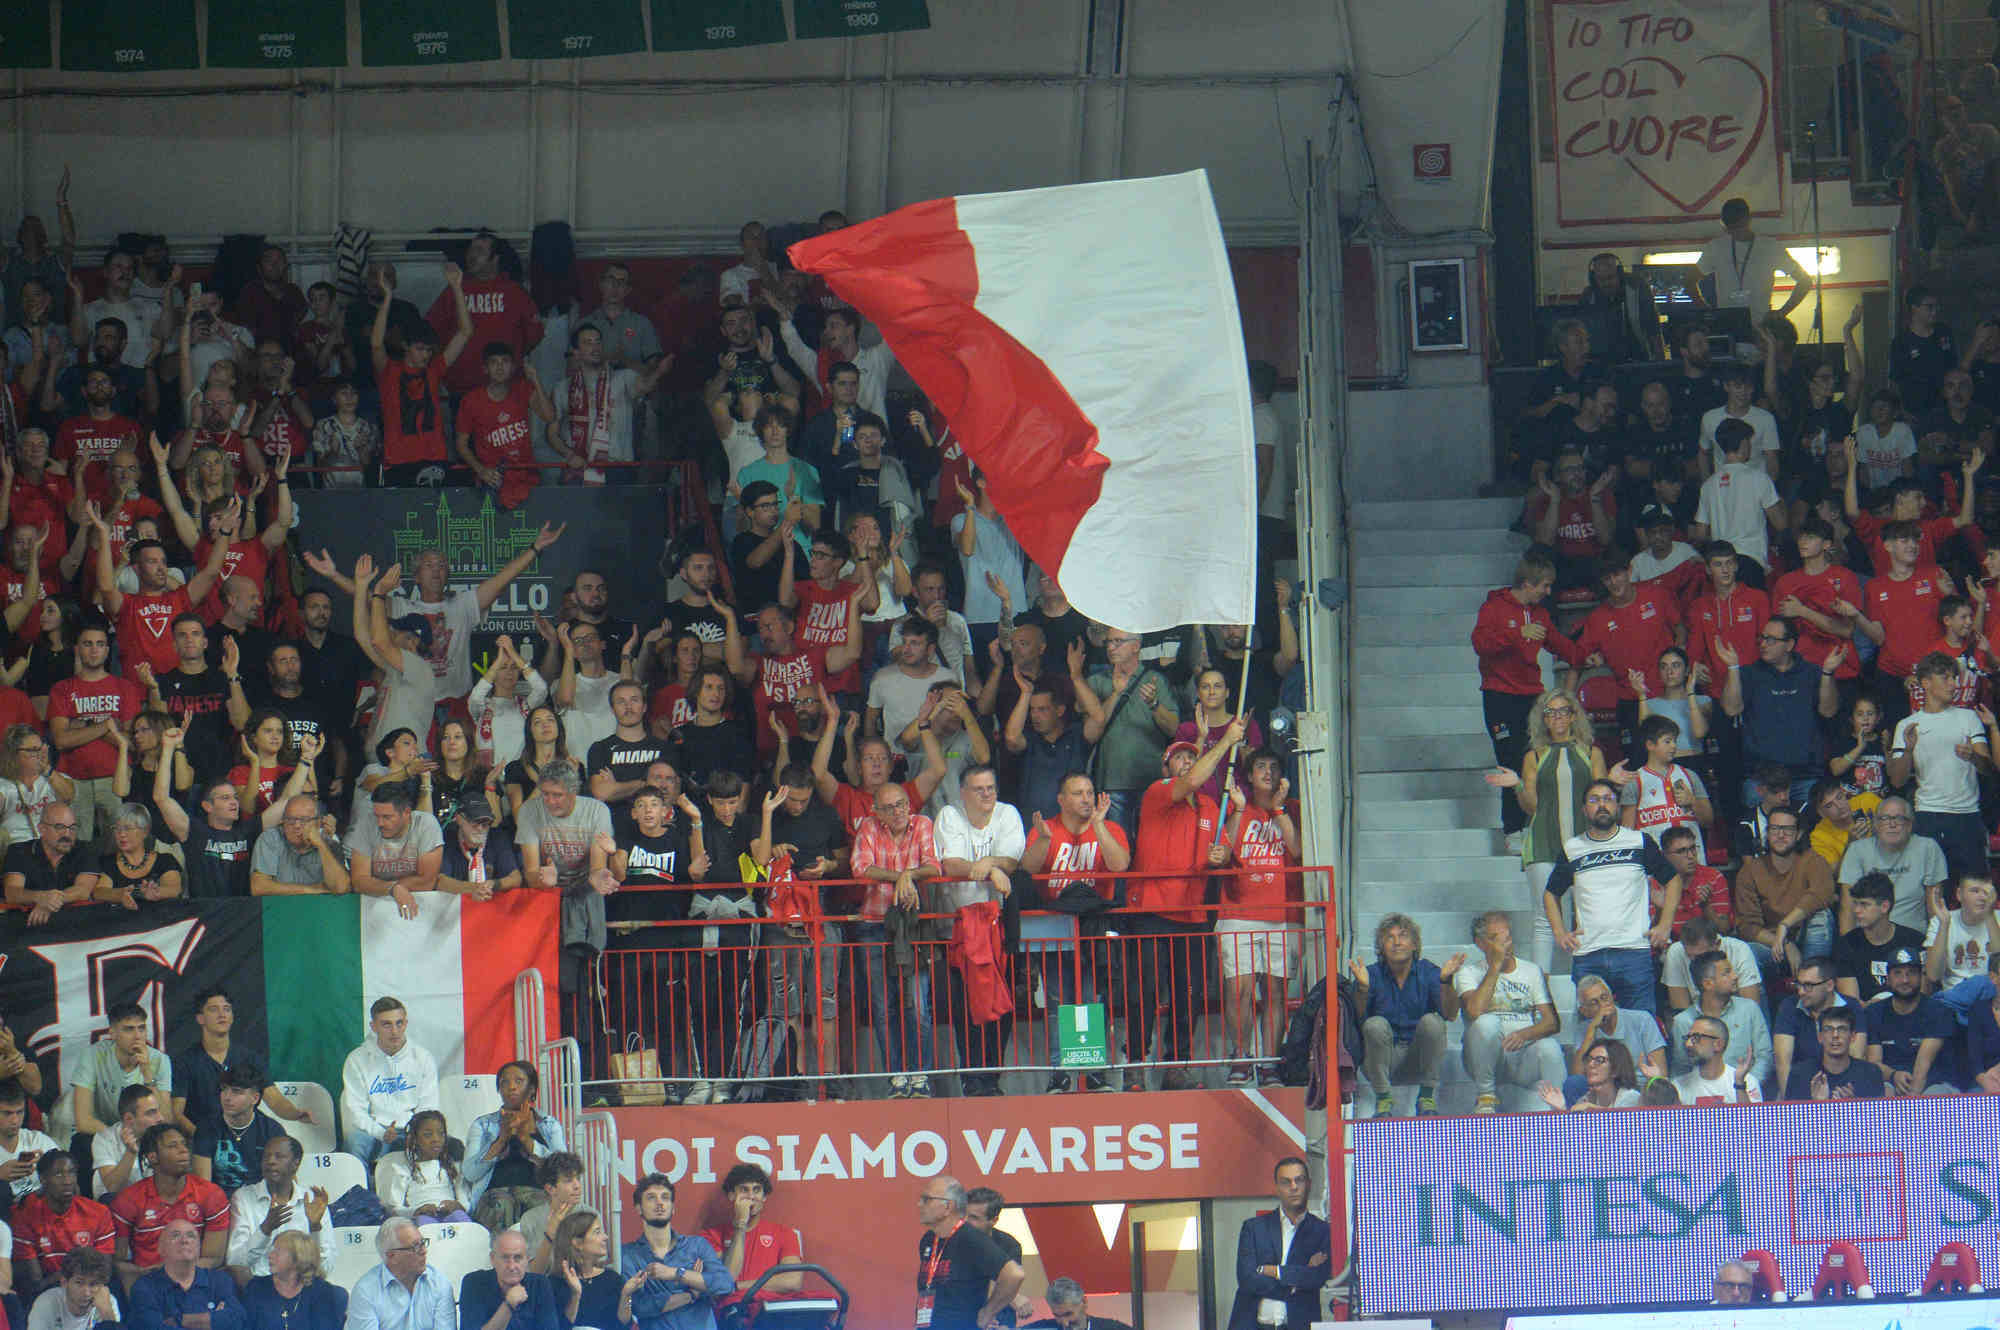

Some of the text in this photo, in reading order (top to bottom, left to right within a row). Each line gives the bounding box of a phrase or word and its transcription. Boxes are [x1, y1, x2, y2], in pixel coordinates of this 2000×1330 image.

[846, 13, 879, 27] 1980
[1618, 14, 1694, 48] TIFO
[113, 49, 144, 62] 1974
[1563, 67, 1657, 101] COL
[1565, 115, 1743, 161] CUORE
[76, 438, 122, 449] VARES
[806, 600, 847, 628] RUN
[508, 620, 536, 632] GUST
[75, 696, 121, 713] VARESE
[1242, 819, 1283, 843] RUN
[1051, 841, 1098, 871] RUN
[284, 1086, 297, 1096] 22
[464, 1079, 478, 1089] 24
[314, 1155, 331, 1168] 18
[600, 1123, 1200, 1187] NOI SIAMO VARESE
[1415, 1159, 1996, 1248] INTESA S
[349, 1233, 362, 1244] 18
[442, 1229, 456, 1240] 19
